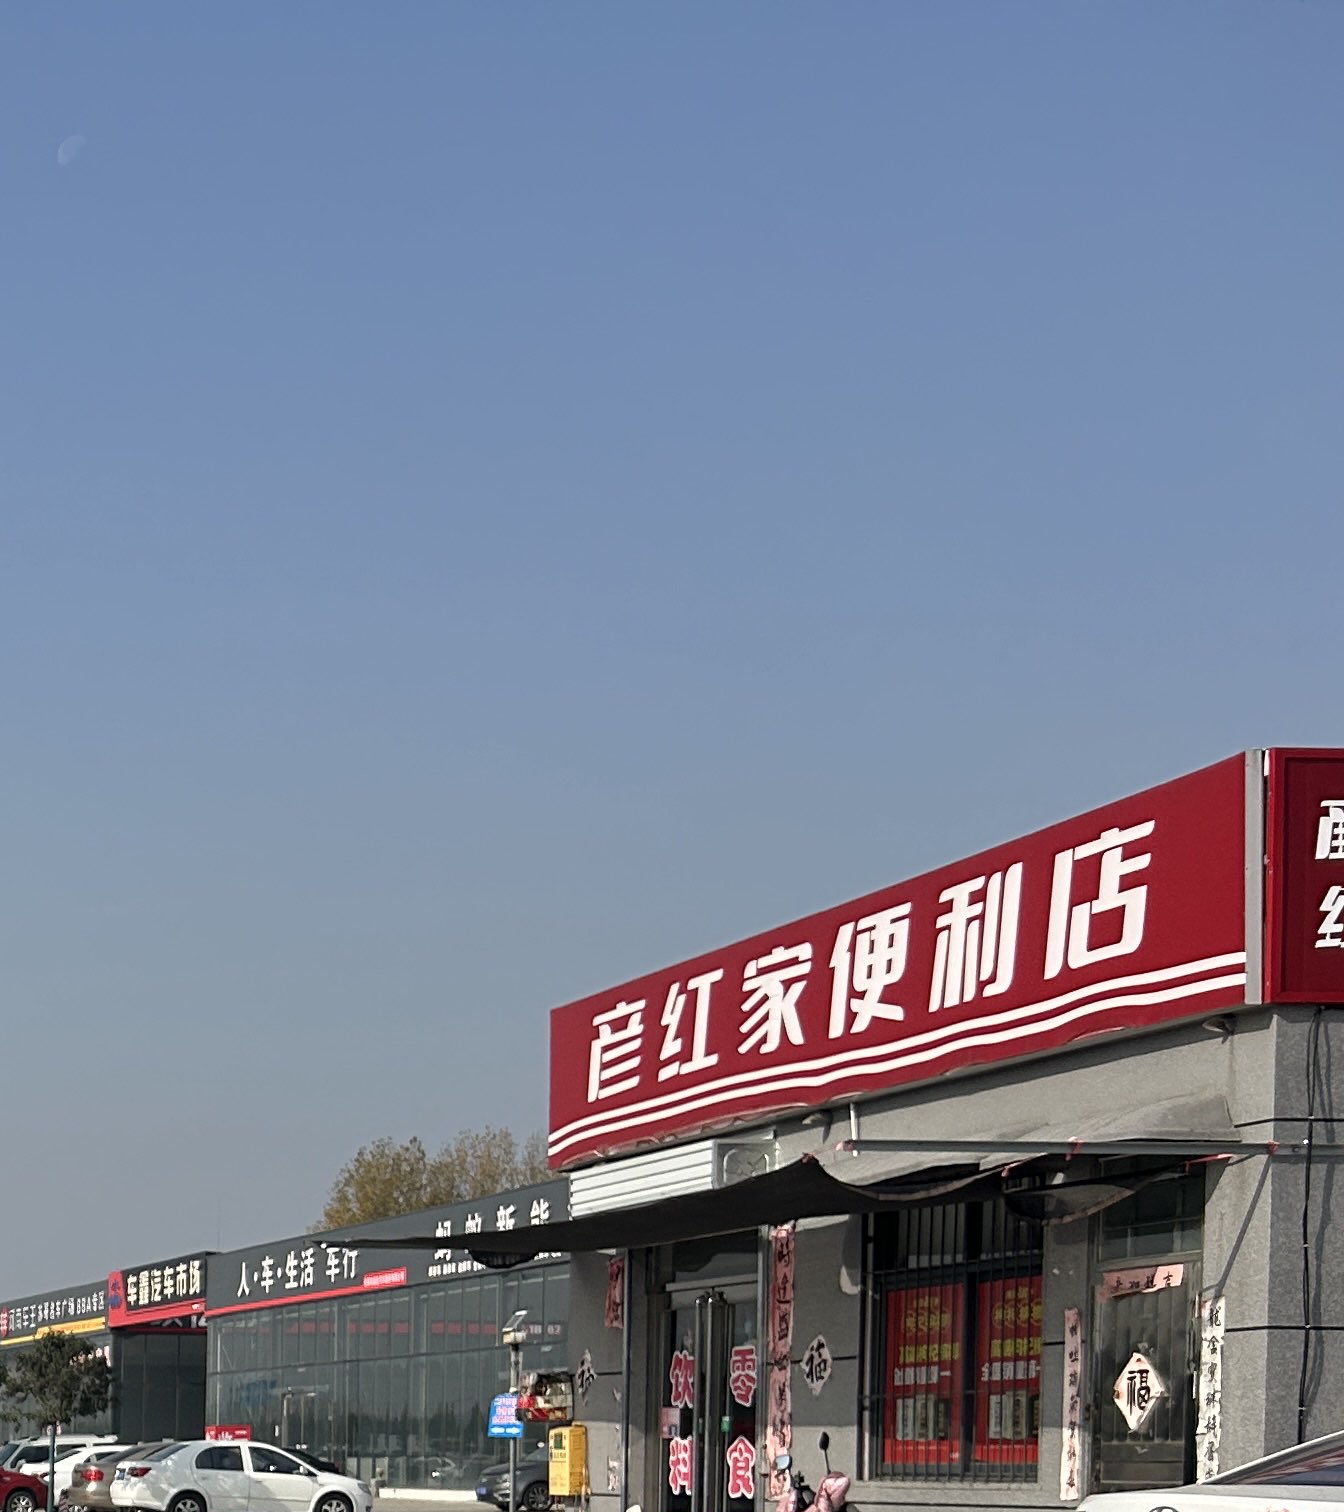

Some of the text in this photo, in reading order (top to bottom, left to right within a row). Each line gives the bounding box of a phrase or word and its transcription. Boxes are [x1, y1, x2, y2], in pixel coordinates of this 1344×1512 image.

[586, 818, 1156, 1104] 彦红家便利店
[727, 1345, 758, 1500] 零食
[1126, 1369, 1151, 1416] 福
